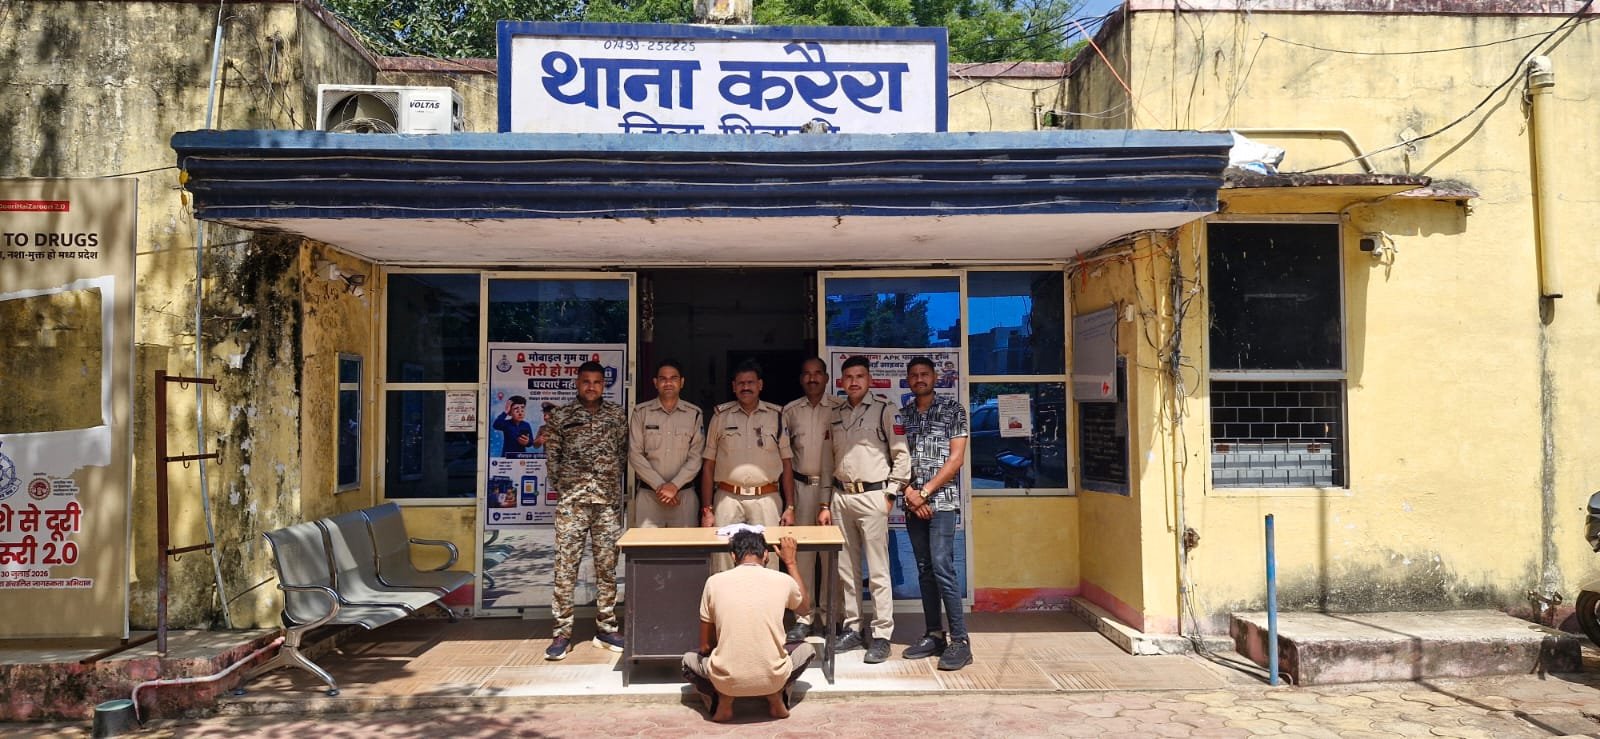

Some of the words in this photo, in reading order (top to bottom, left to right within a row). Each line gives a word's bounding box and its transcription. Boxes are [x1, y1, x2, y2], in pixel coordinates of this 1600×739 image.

[541, 50, 701, 110] थाना
[718, 42, 909, 114] करैरा
[409, 101, 440, 109] VOLTAS
[4, 233, 29, 247] TO
[34, 233, 98, 247] DRUGS
[58, 250, 76, 260] मध्य
[78, 249, 98, 260] प्रदेश
[528, 352, 561, 362] मोबाइल
[563, 353, 577, 364] गुम
[578, 353, 589, 362] या
[522, 363, 548, 377] चोरी
[550, 363, 562, 377] हो
[18, 503, 41, 533] से
[45, 502, 81, 541] दूरी
[43, 542, 78, 565] 2.0
[32, 570, 49, 578] 2026
